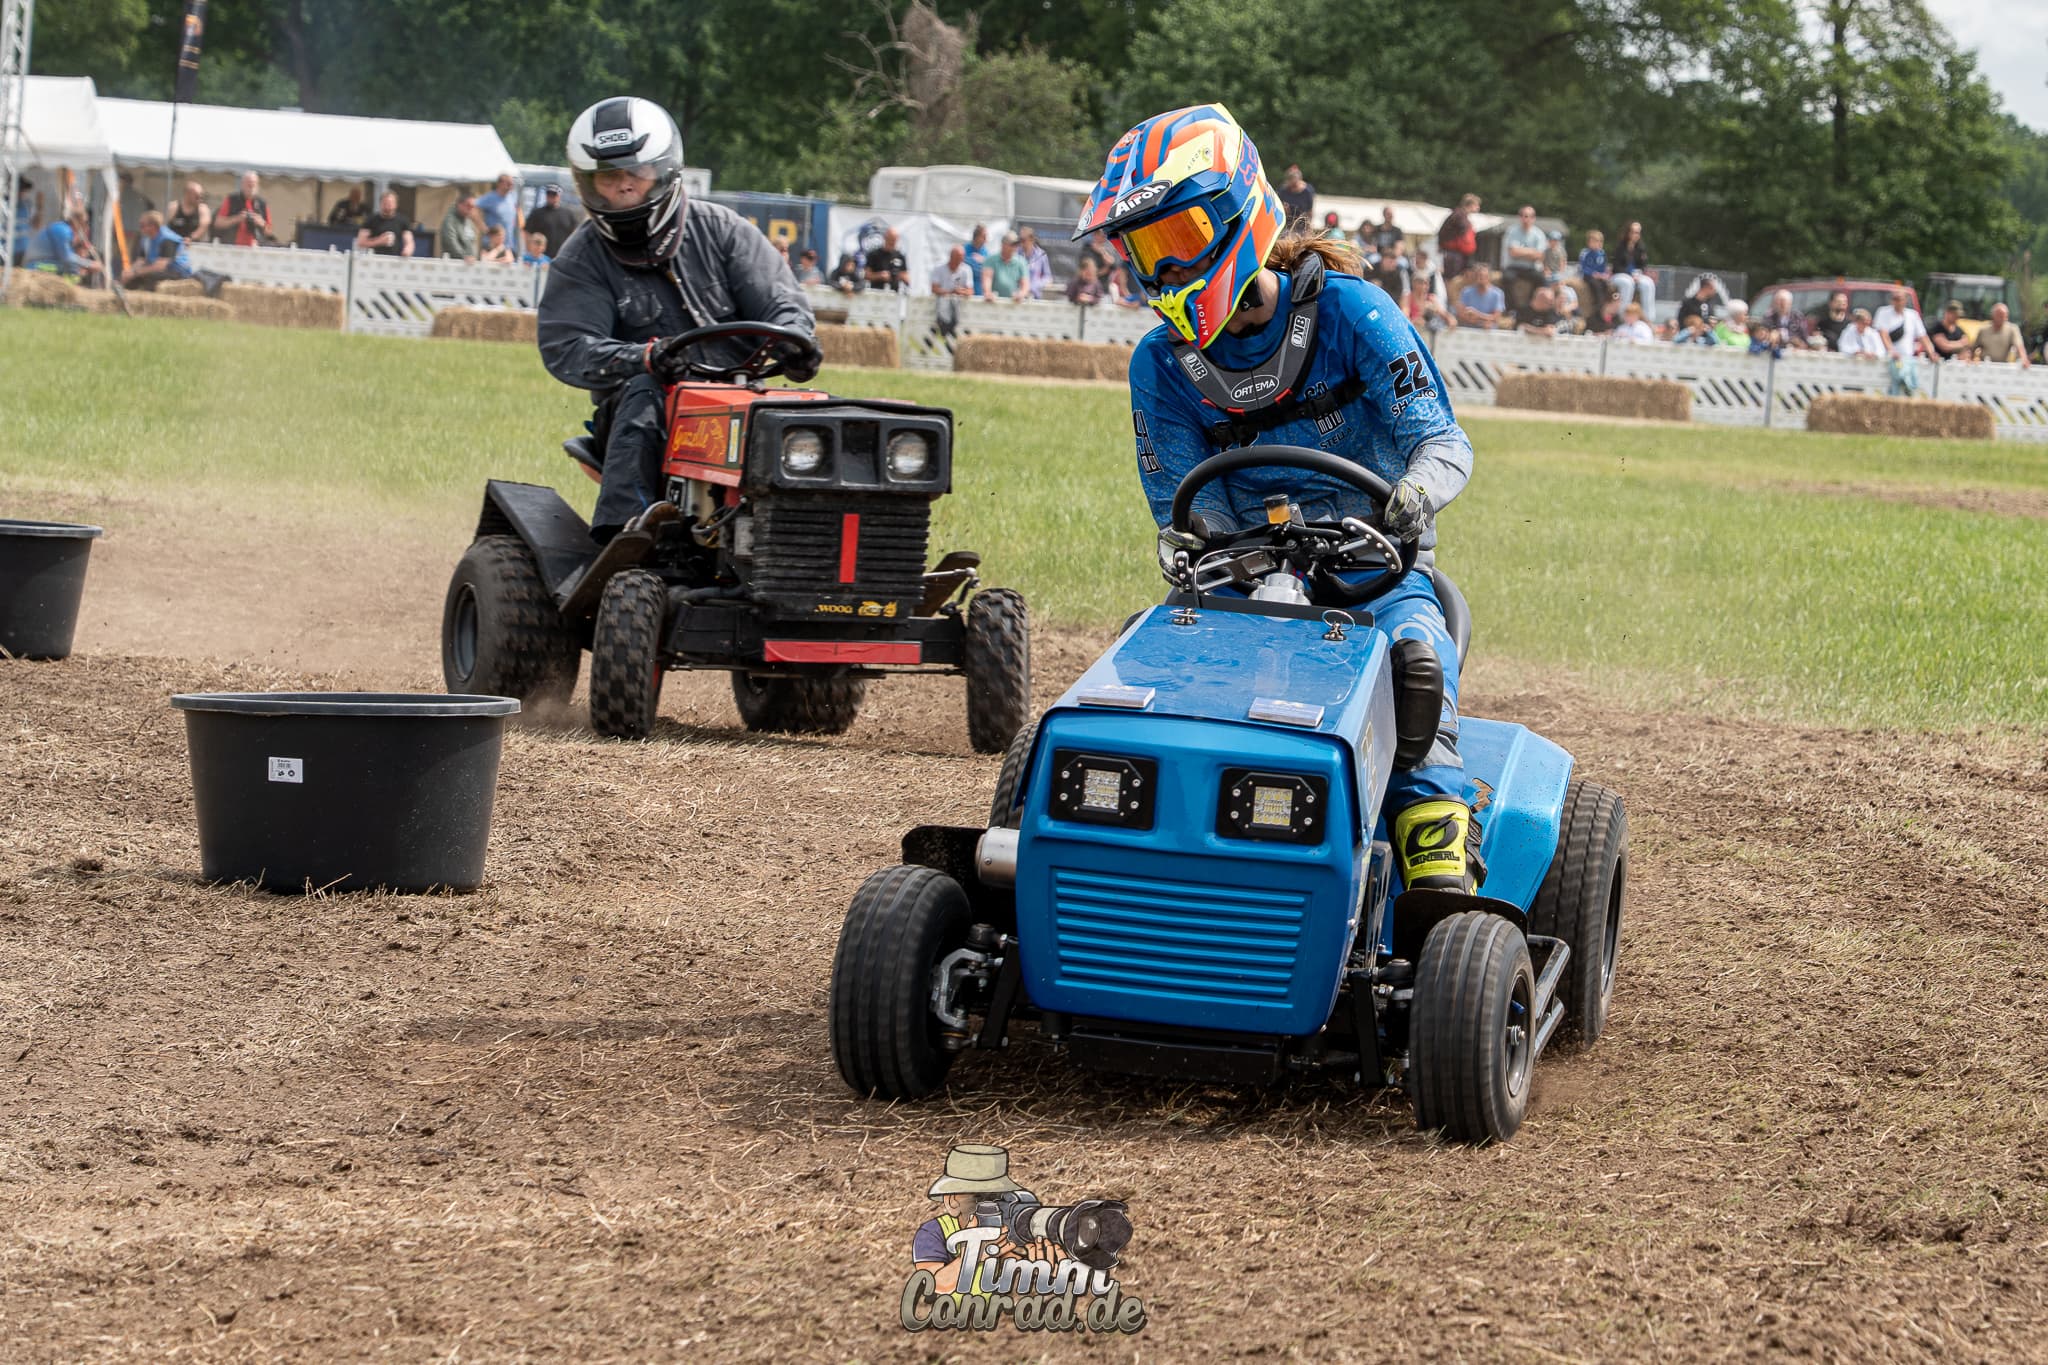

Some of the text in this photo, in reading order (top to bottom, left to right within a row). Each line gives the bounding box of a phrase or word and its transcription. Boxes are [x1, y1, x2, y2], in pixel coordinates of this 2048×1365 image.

[599, 132, 628, 145] SHOEI
[1195, 303, 1209, 336] AIROH
[1388, 350, 1430, 400] 22
[1233, 379, 1277, 400] ORTEMA
